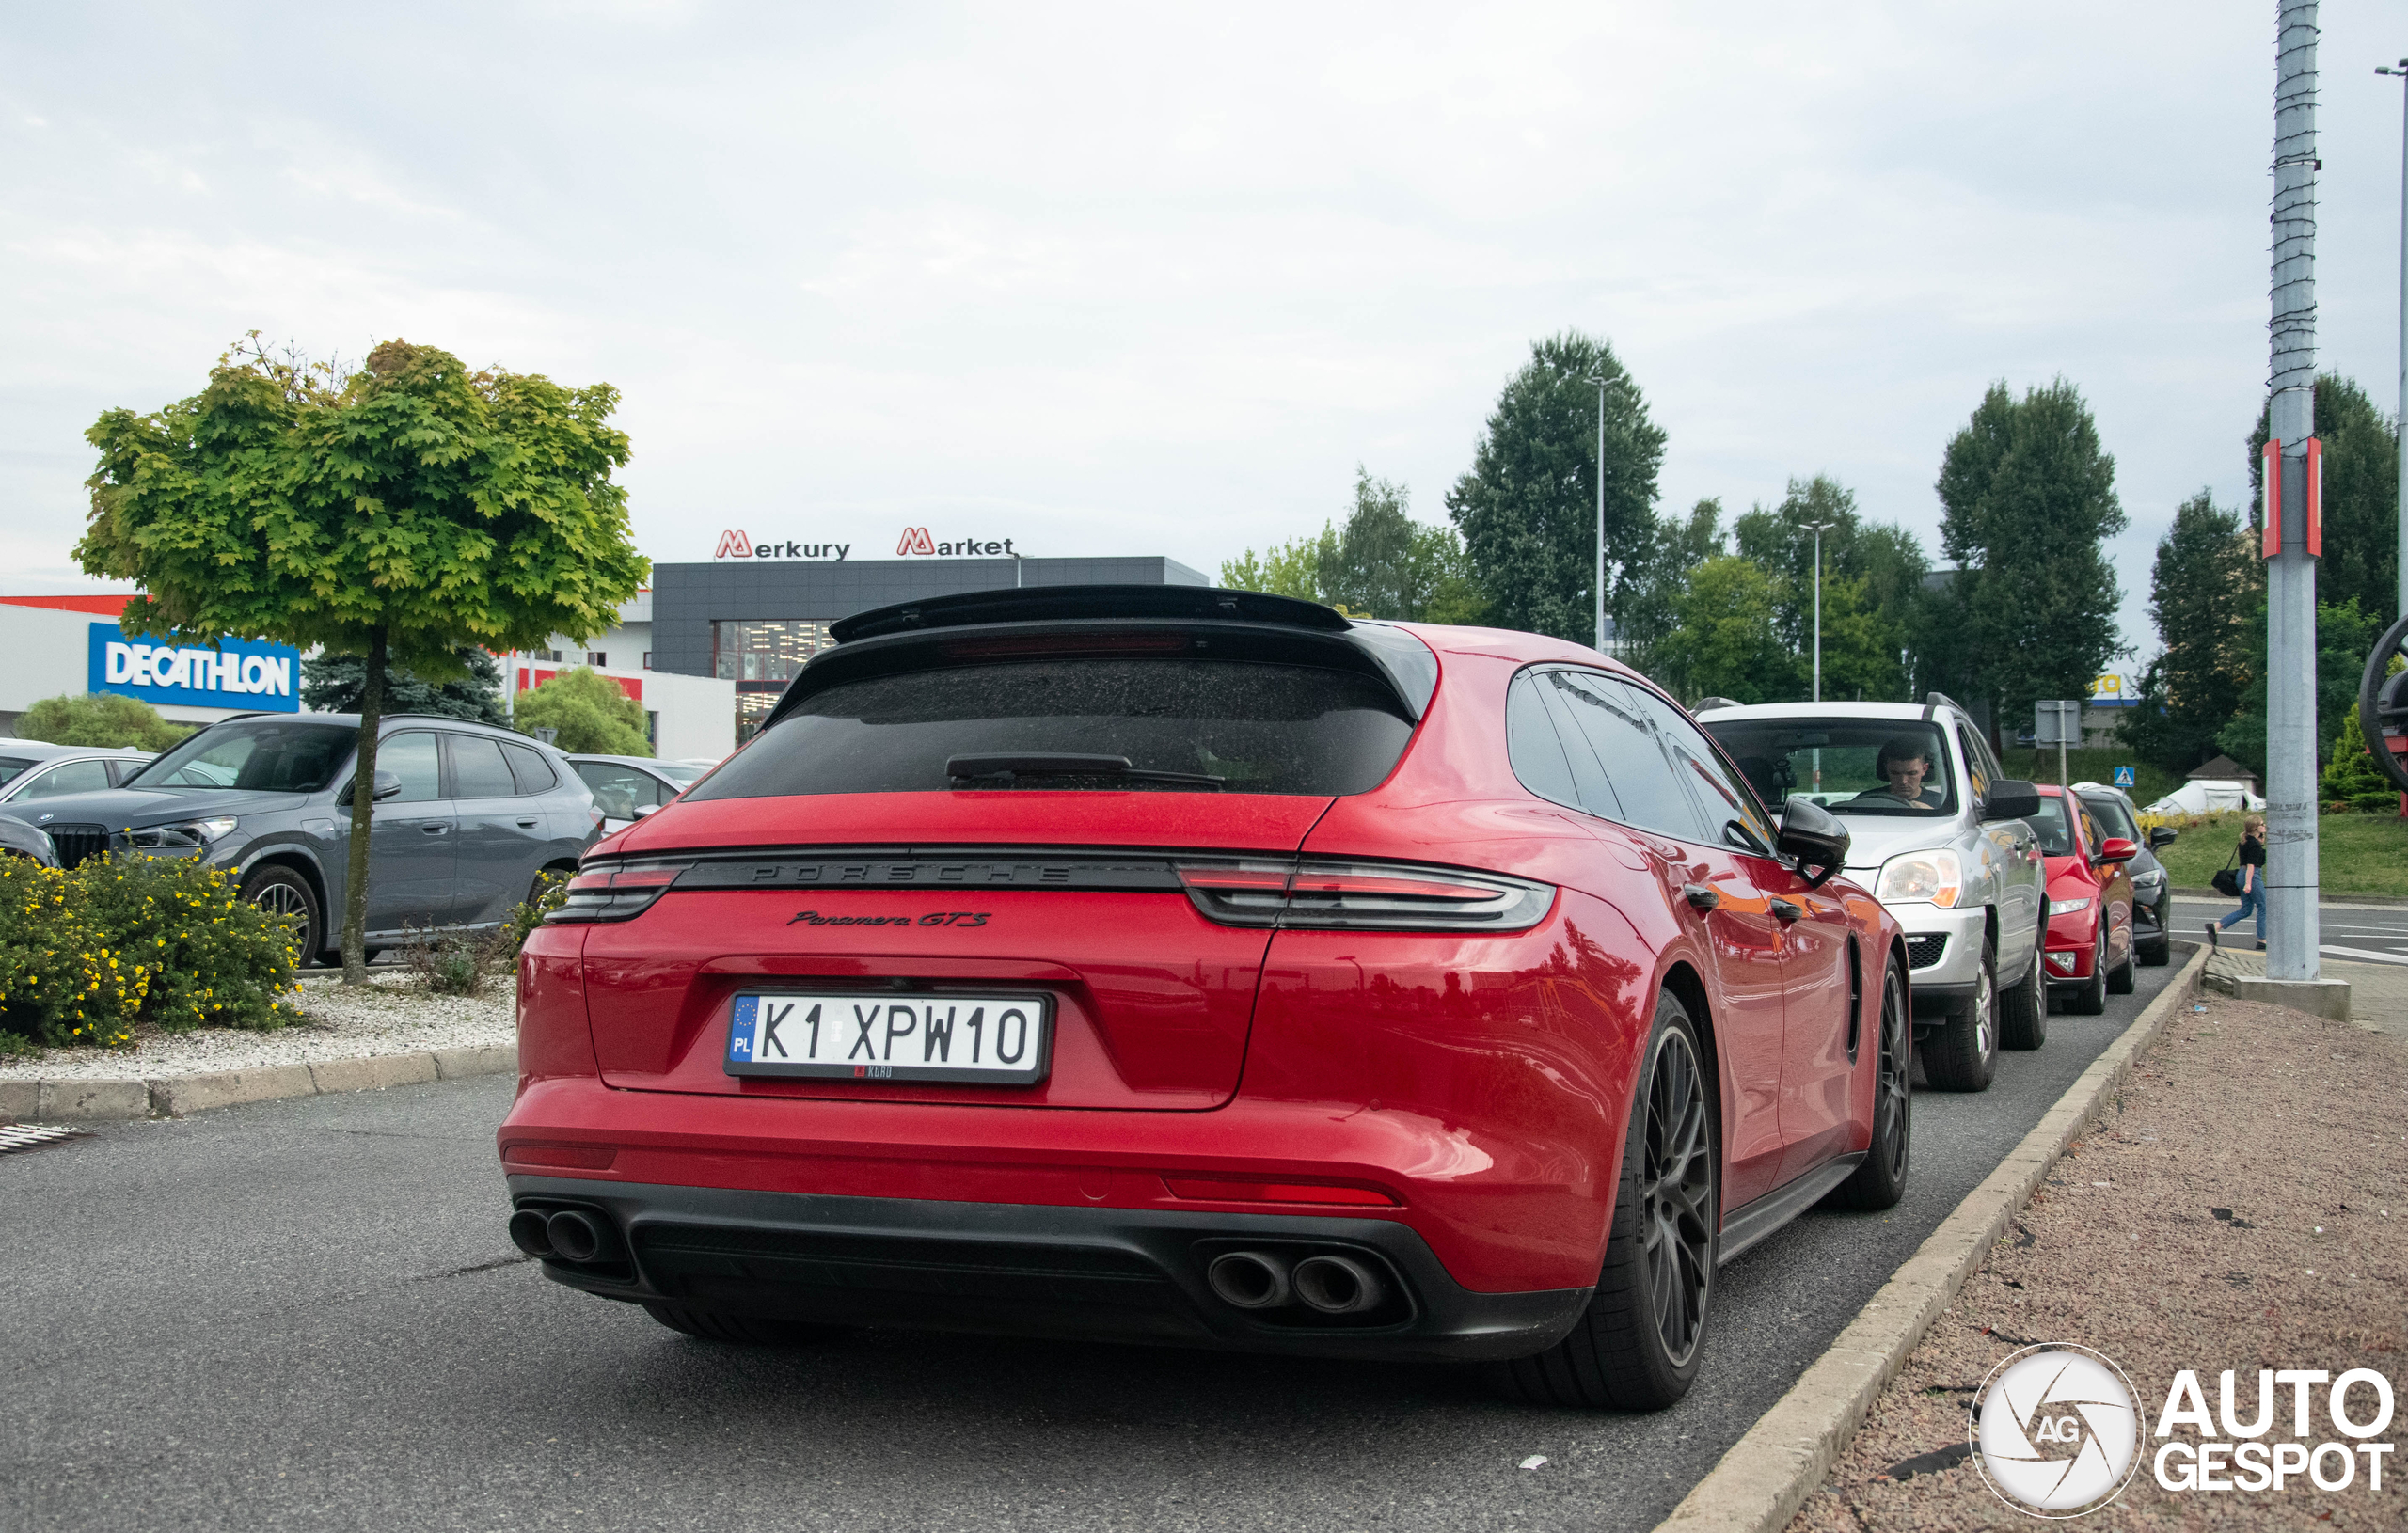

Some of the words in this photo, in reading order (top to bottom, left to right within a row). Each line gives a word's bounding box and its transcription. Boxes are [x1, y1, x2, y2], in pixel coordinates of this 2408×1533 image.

[716, 529, 850, 561] Merkury
[896, 527, 1014, 557] Market
[105, 641, 291, 697] DECATHLON
[752, 864, 1070, 883] PORSCHE
[786, 910, 911, 926] Panamera
[917, 911, 992, 927] GTS
[733, 1037, 751, 1053] PL
[762, 1003, 823, 1059] K1
[848, 1004, 1028, 1065] XPW10
